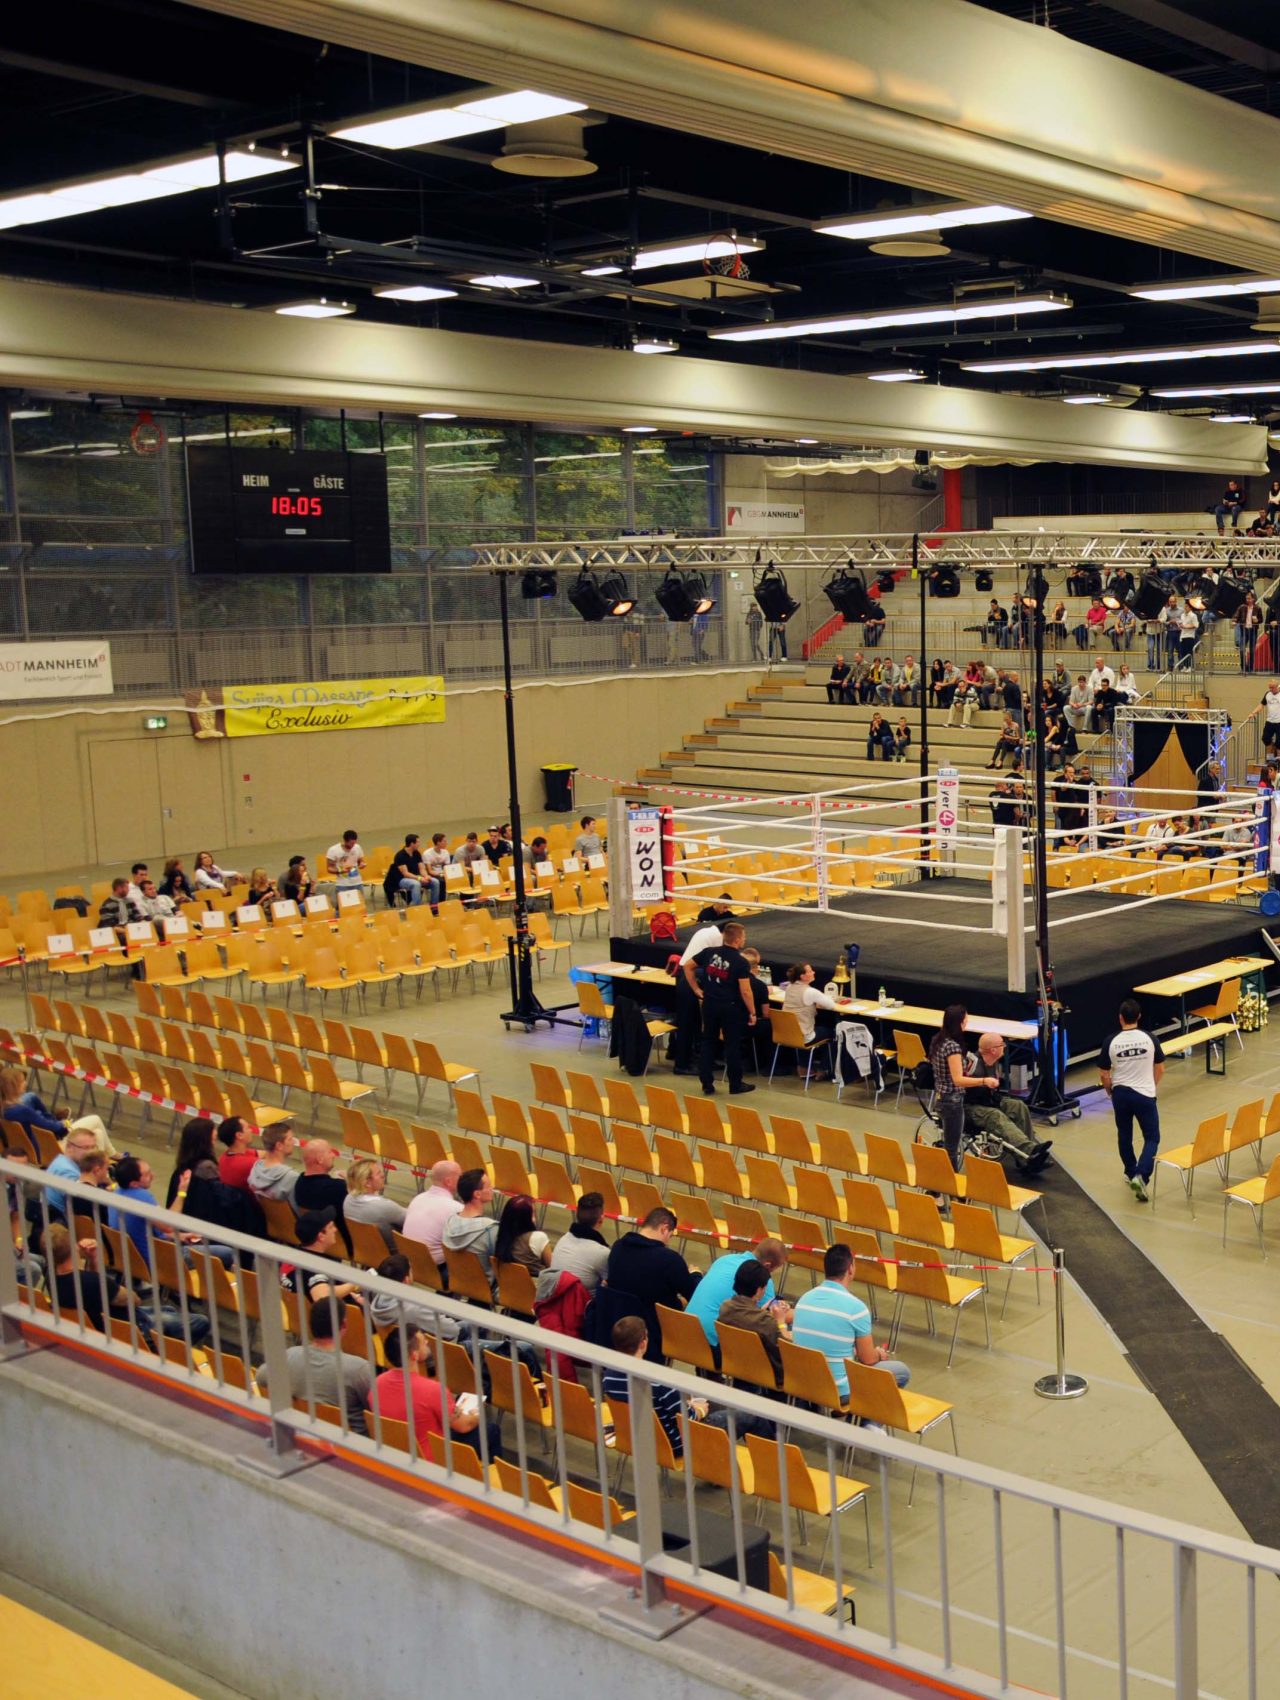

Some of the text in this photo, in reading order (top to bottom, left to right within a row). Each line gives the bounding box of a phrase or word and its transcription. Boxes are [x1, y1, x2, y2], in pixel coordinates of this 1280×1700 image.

[242, 474, 345, 490] HEIM GÄSTE
[271, 496, 322, 516] 18:05
[265, 704, 353, 730] Exclusiv
